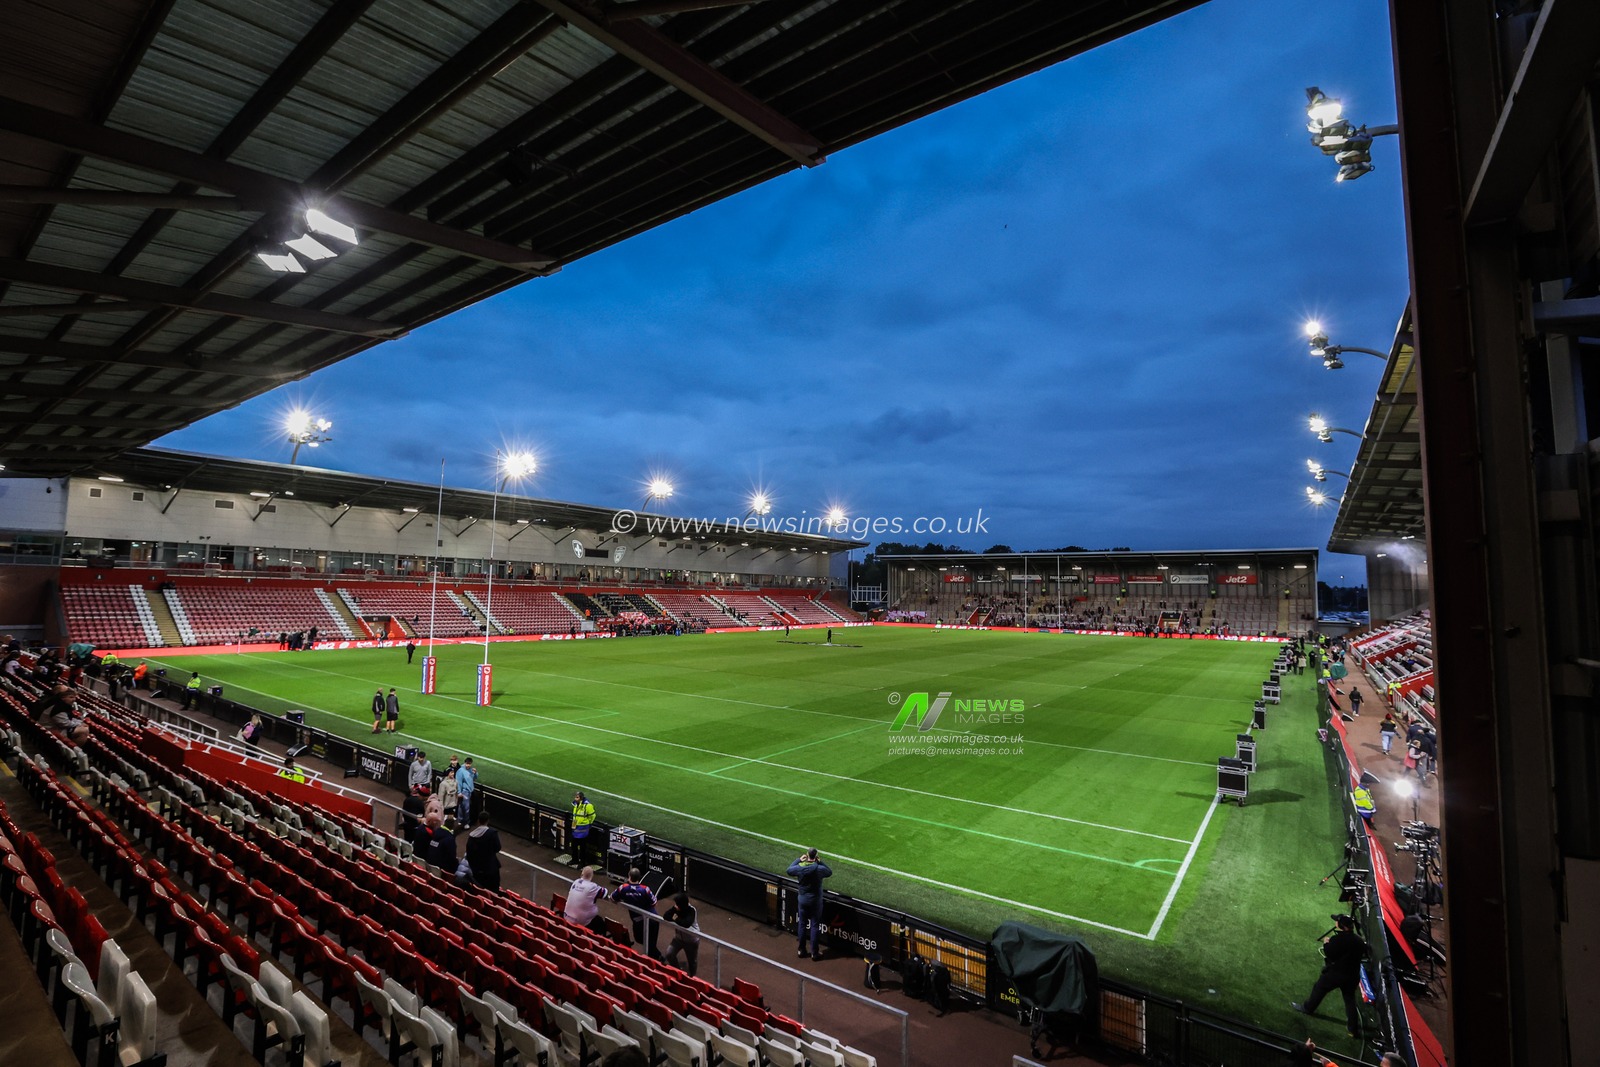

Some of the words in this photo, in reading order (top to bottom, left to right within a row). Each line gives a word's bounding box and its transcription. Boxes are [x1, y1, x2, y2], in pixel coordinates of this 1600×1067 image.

[950, 575, 965, 583] Jet2
[1225, 575, 1247, 583] Jet2
[314, 641, 335, 650] Jet2
[361, 756, 380, 771] TACKLE
[105, 1032, 115, 1045] K
[295, 1043, 301, 1054] J
[436, 1052, 442, 1060] H
